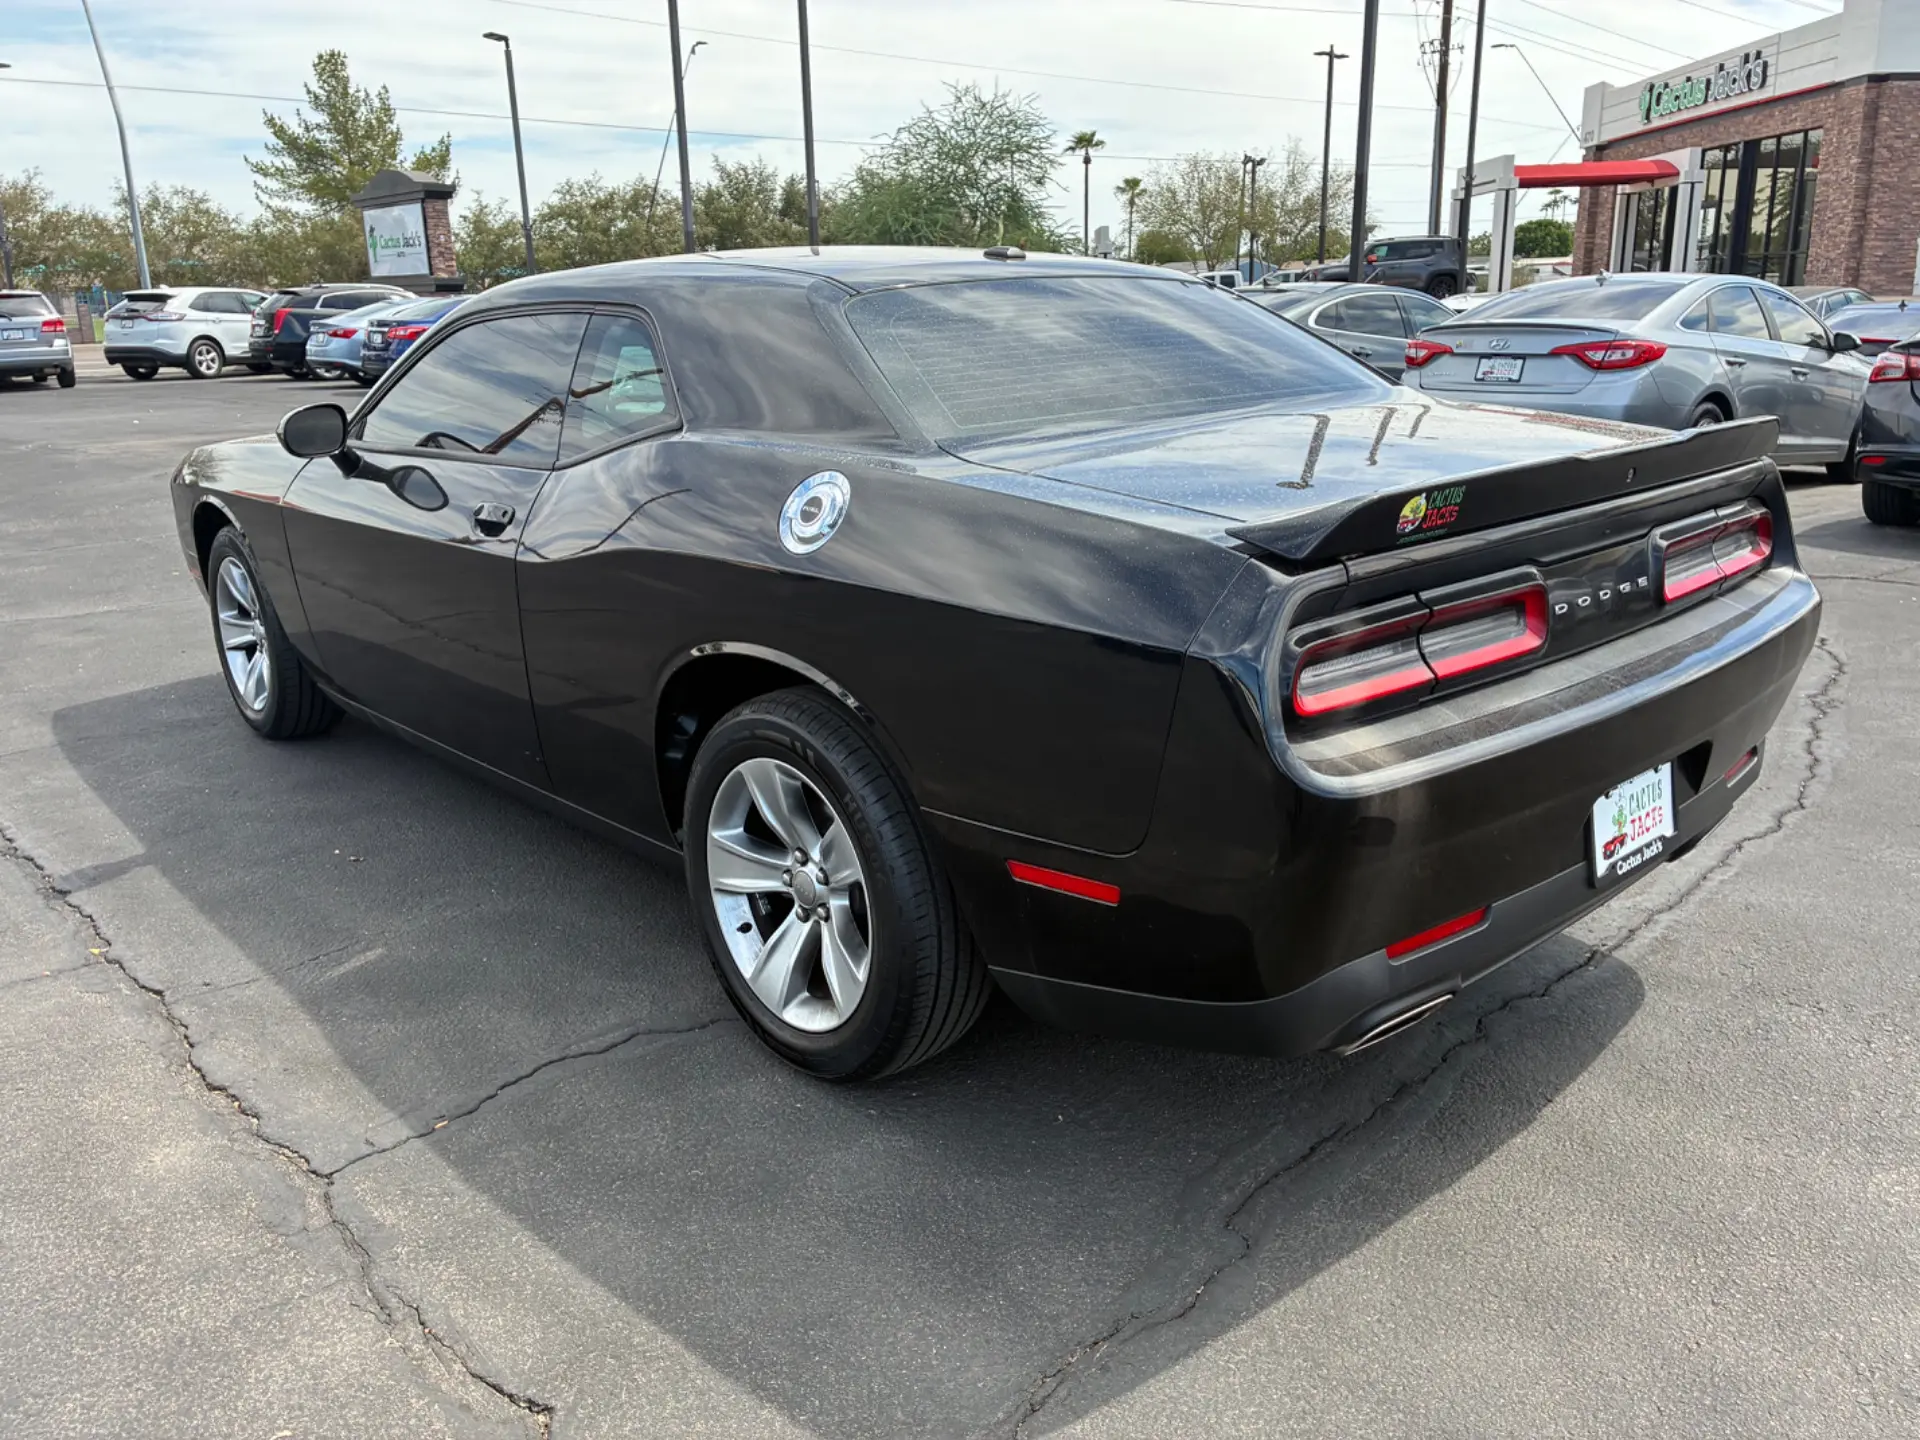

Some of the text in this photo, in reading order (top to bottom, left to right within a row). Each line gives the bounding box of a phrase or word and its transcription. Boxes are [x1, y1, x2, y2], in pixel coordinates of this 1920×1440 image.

[1650, 50, 1766, 118] Cactus Jack's
[379, 230, 422, 249] Cactus Jack's
[1427, 485, 1466, 509] CACTUS
[1422, 505, 1460, 529] JACKS
[1554, 576, 1648, 615] DODGE
[1628, 778, 1663, 816] CACTUS
[1628, 805, 1664, 841] JACKS
[1616, 837, 1663, 876] Cactus Jack's
